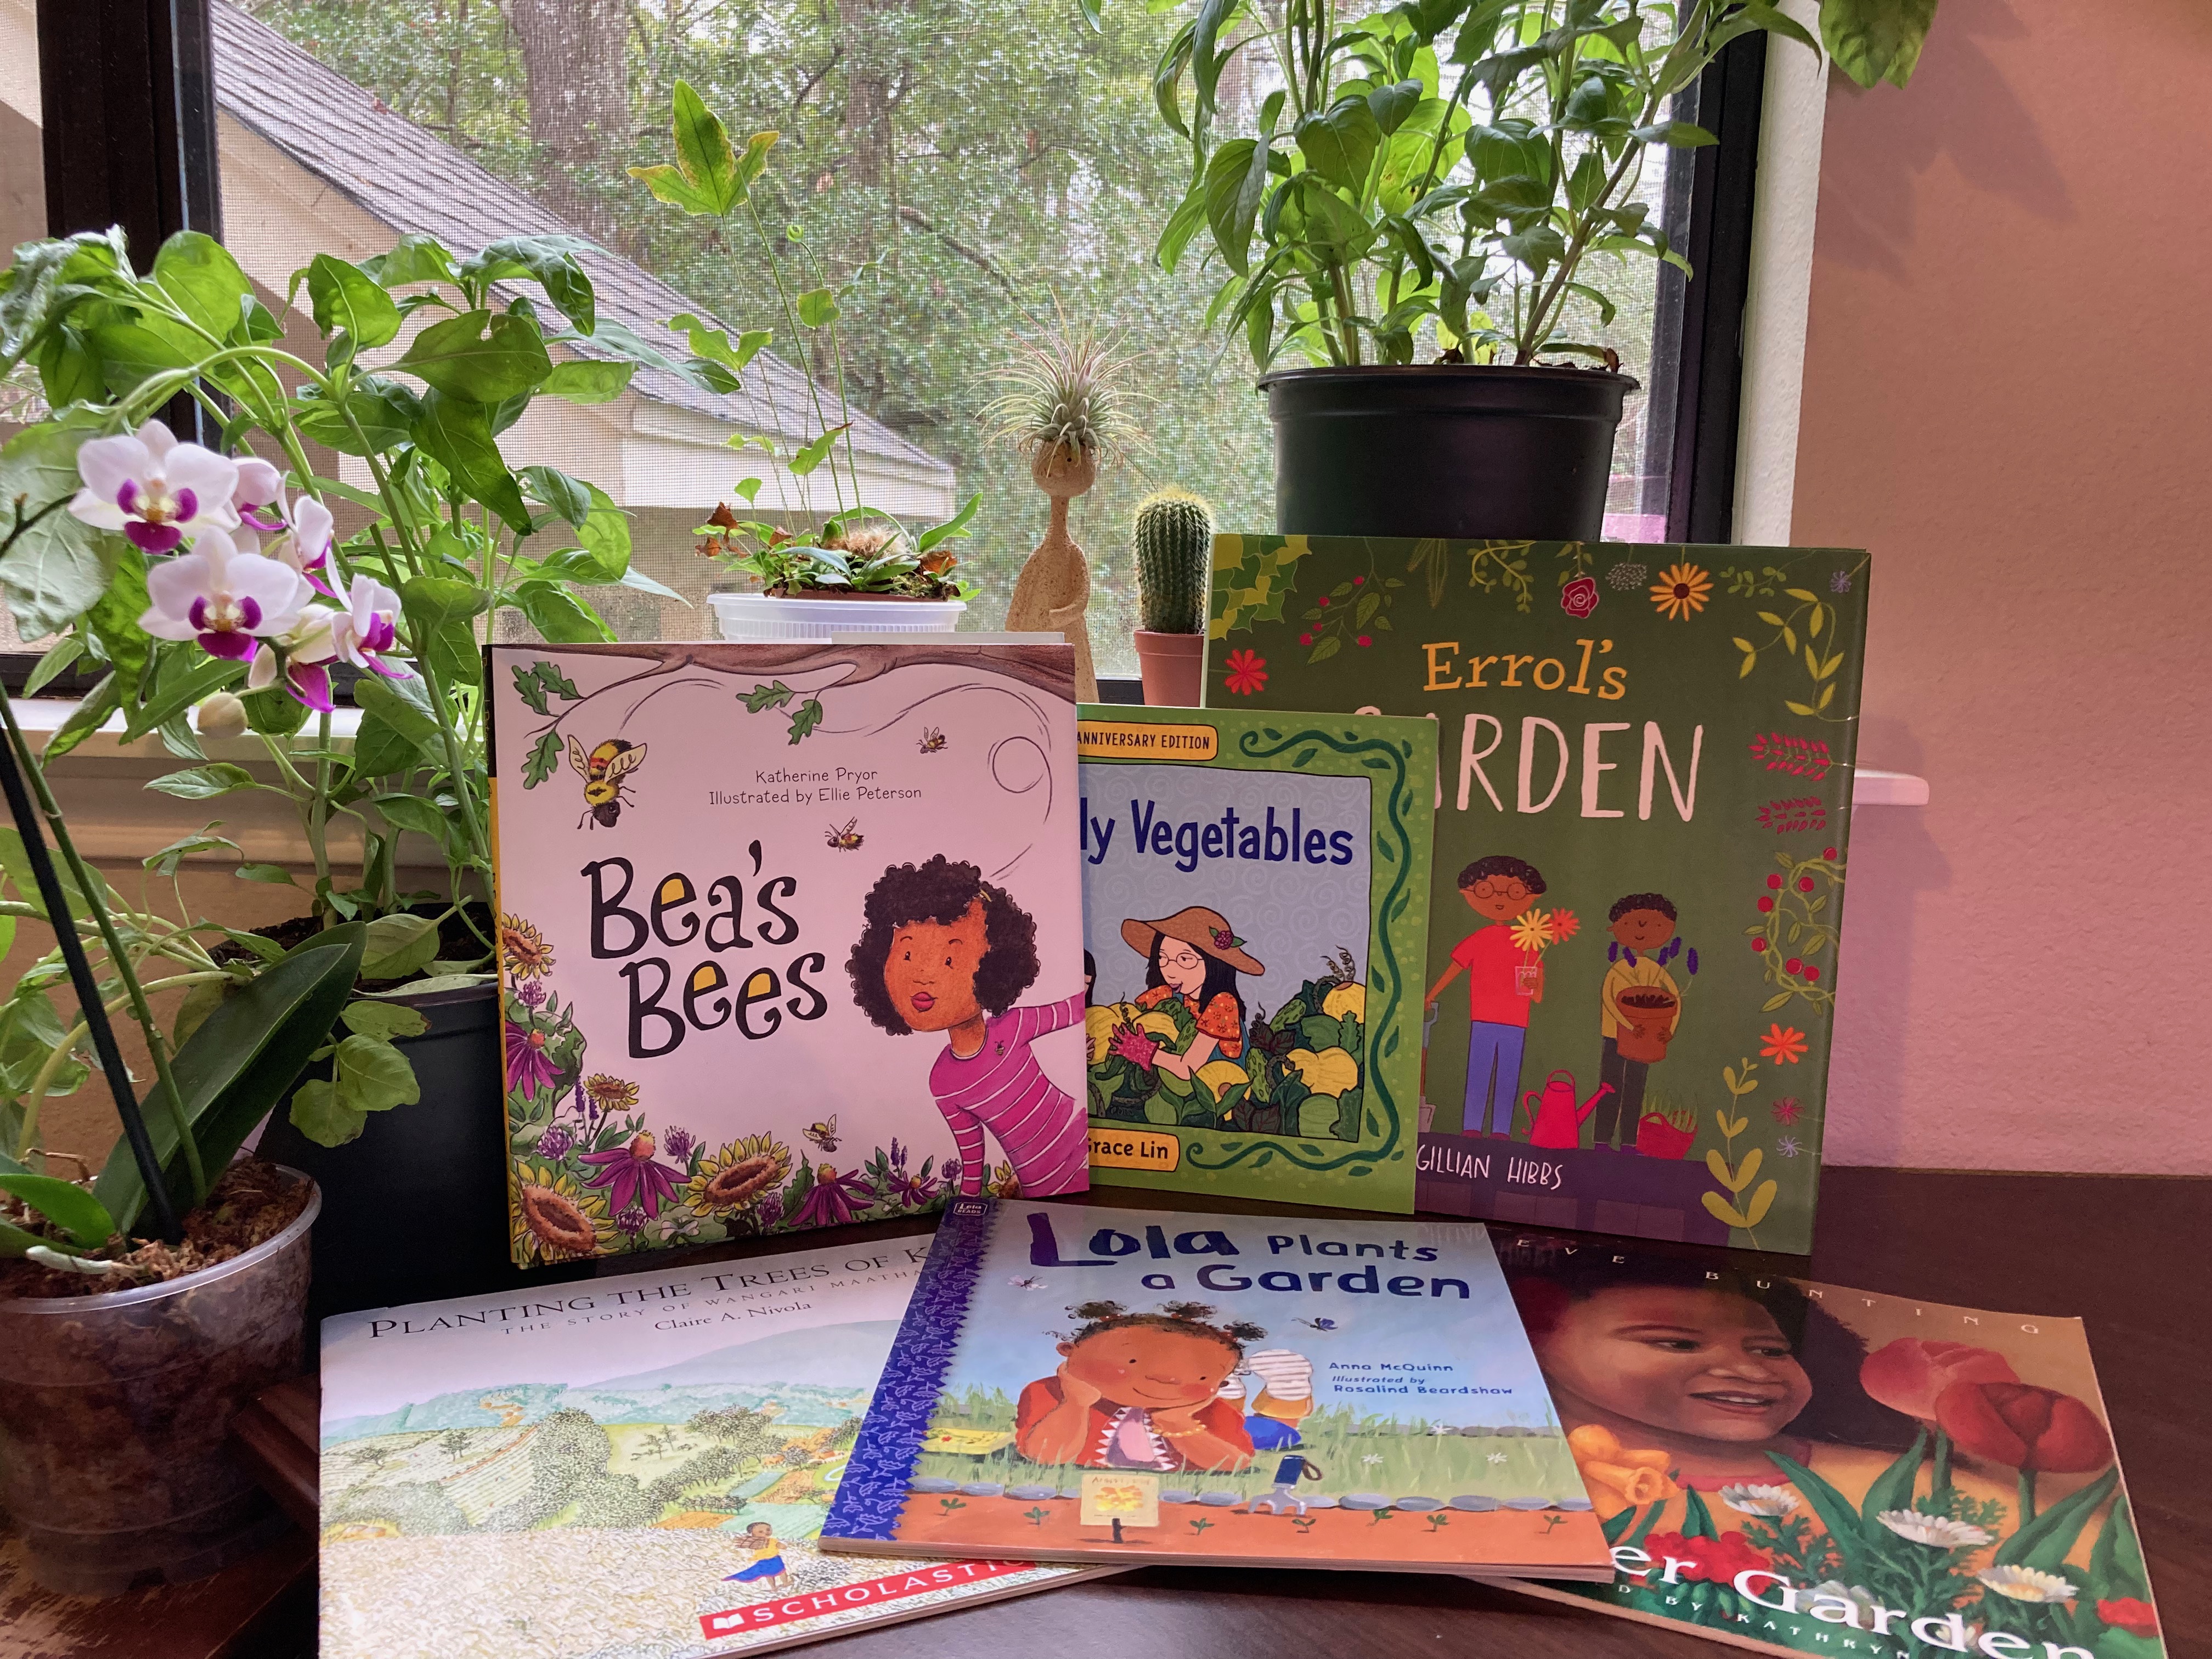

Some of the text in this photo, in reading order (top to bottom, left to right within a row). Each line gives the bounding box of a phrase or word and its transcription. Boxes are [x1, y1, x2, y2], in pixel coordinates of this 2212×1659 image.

[1421, 639, 1628, 700] Errol's
[1077, 731, 1210, 750] ANNIVERSARY EDITION
[756, 767, 878, 785] Katherine Pryor
[1355, 706, 1704, 822] RDEN
[709, 786, 922, 805] Illustrated by Ellie Peterson
[1131, 799, 1353, 872] Vegetables
[580, 840, 800, 959] Bea's
[619, 952, 828, 1059] Bees
[1141, 1141, 1168, 1159] Lin
[1416, 1144, 1563, 1190] GILLIAN HIBBS
[1026, 1212, 1240, 1267] Lola
[1267, 1233, 1438, 1262] Plants
[368, 1296, 595, 1339] PLANTING
[607, 1283, 691, 1305] THE
[701, 1264, 830, 1293] TREES
[844, 1255, 889, 1272] OF
[1141, 1264, 1471, 1299] a Garden
[500, 1322, 551, 1335] THE
[568, 1308, 645, 1326] STORY
[662, 1302, 692, 1312] OF
[704, 1285, 816, 1307] WANGARI
[654, 1301, 813, 1330] Claire A. Nivola
[1329, 1362, 1454, 1372] Anna McQuinn
[1331, 1375, 1425, 1385] Illustrated by
[1334, 1384, 1513, 1395] Rosalind Beardshaw
[1733, 1568, 2097, 1659] Garden
